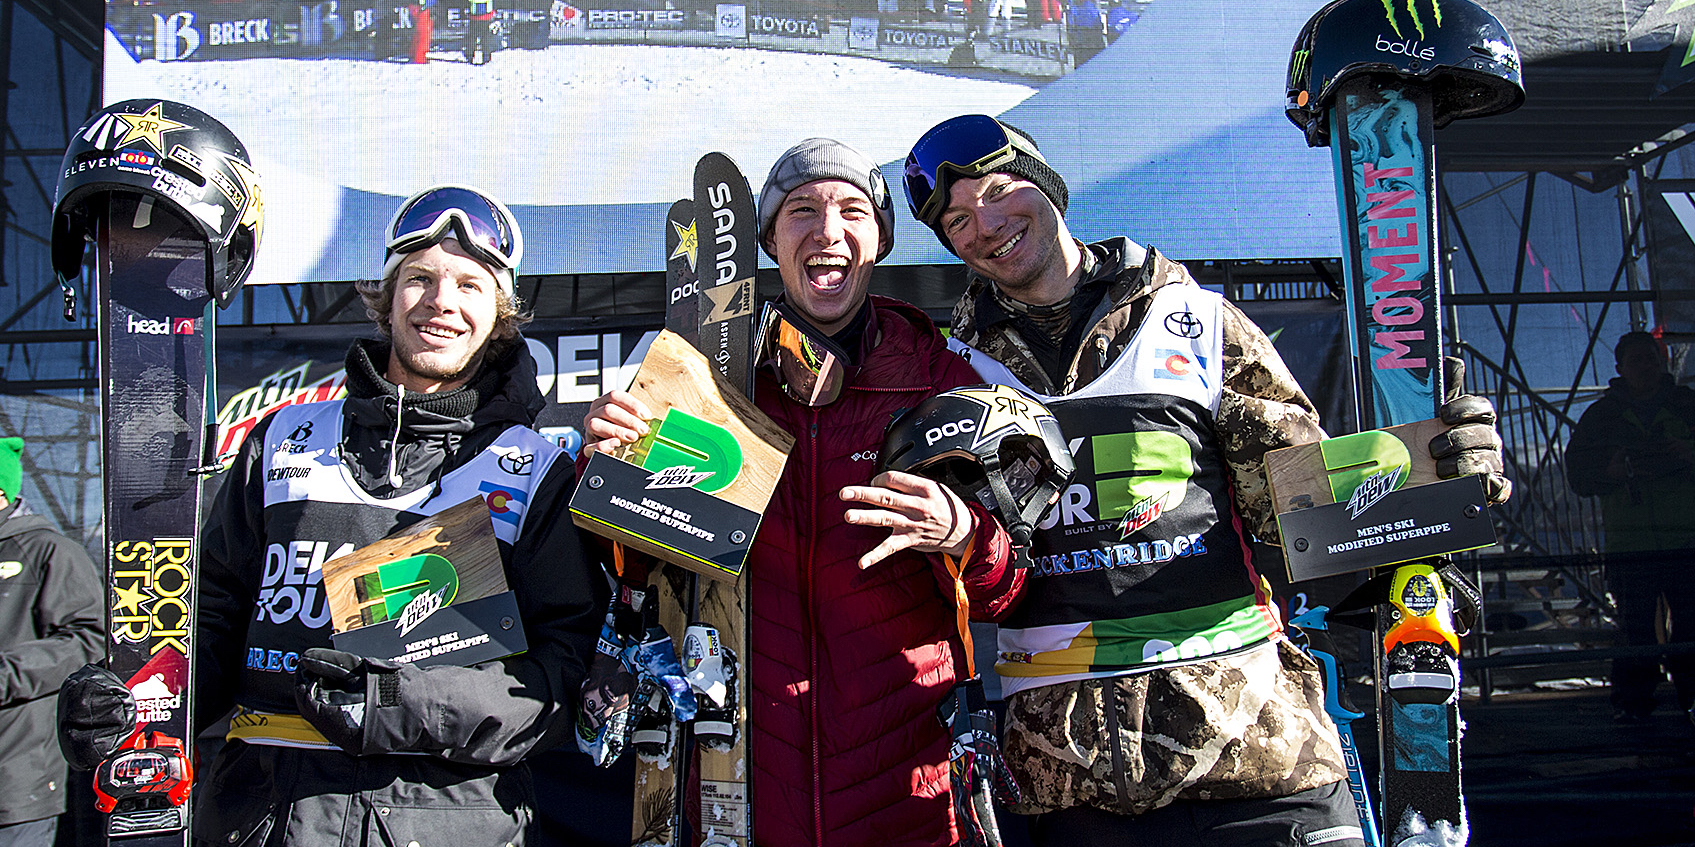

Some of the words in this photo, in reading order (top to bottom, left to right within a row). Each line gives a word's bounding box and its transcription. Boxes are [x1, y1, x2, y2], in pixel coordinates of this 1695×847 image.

[209, 19, 270, 45] BRECK
[751, 15, 820, 36] TOYOTA
[885, 29, 950, 47] TOYOTA
[1375, 34, 1436, 61] bollé
[64, 156, 121, 179] ELEVEN
[1362, 162, 1428, 370] MOMENT
[743, 281, 751, 312] 4FRNT
[127, 314, 171, 335] head
[720, 321, 729, 349] ASPEN
[609, 495, 660, 521] MODIFIED
[659, 514, 716, 543] SUPERPIPE
[641, 497, 673, 516] MEN'S
[672, 509, 692, 523] SKI
[1064, 525, 1095, 536] BUILT
[1097, 522, 1113, 532] BY
[1327, 536, 1385, 555] MODIFIED
[1385, 522, 1451, 543] SUPERPIPE
[1356, 523, 1392, 538] MEN'S
[1393, 518, 1416, 530] SKI
[1032, 533, 1208, 578] ECKENRIDGE
[150, 539, 192, 656] ROCK
[256, 586, 334, 630] TOU
[431, 634, 491, 657] SUPERPIPE
[439, 631, 460, 645] SKI
[136, 695, 181, 710] ested
[136, 709, 172, 723] utte
